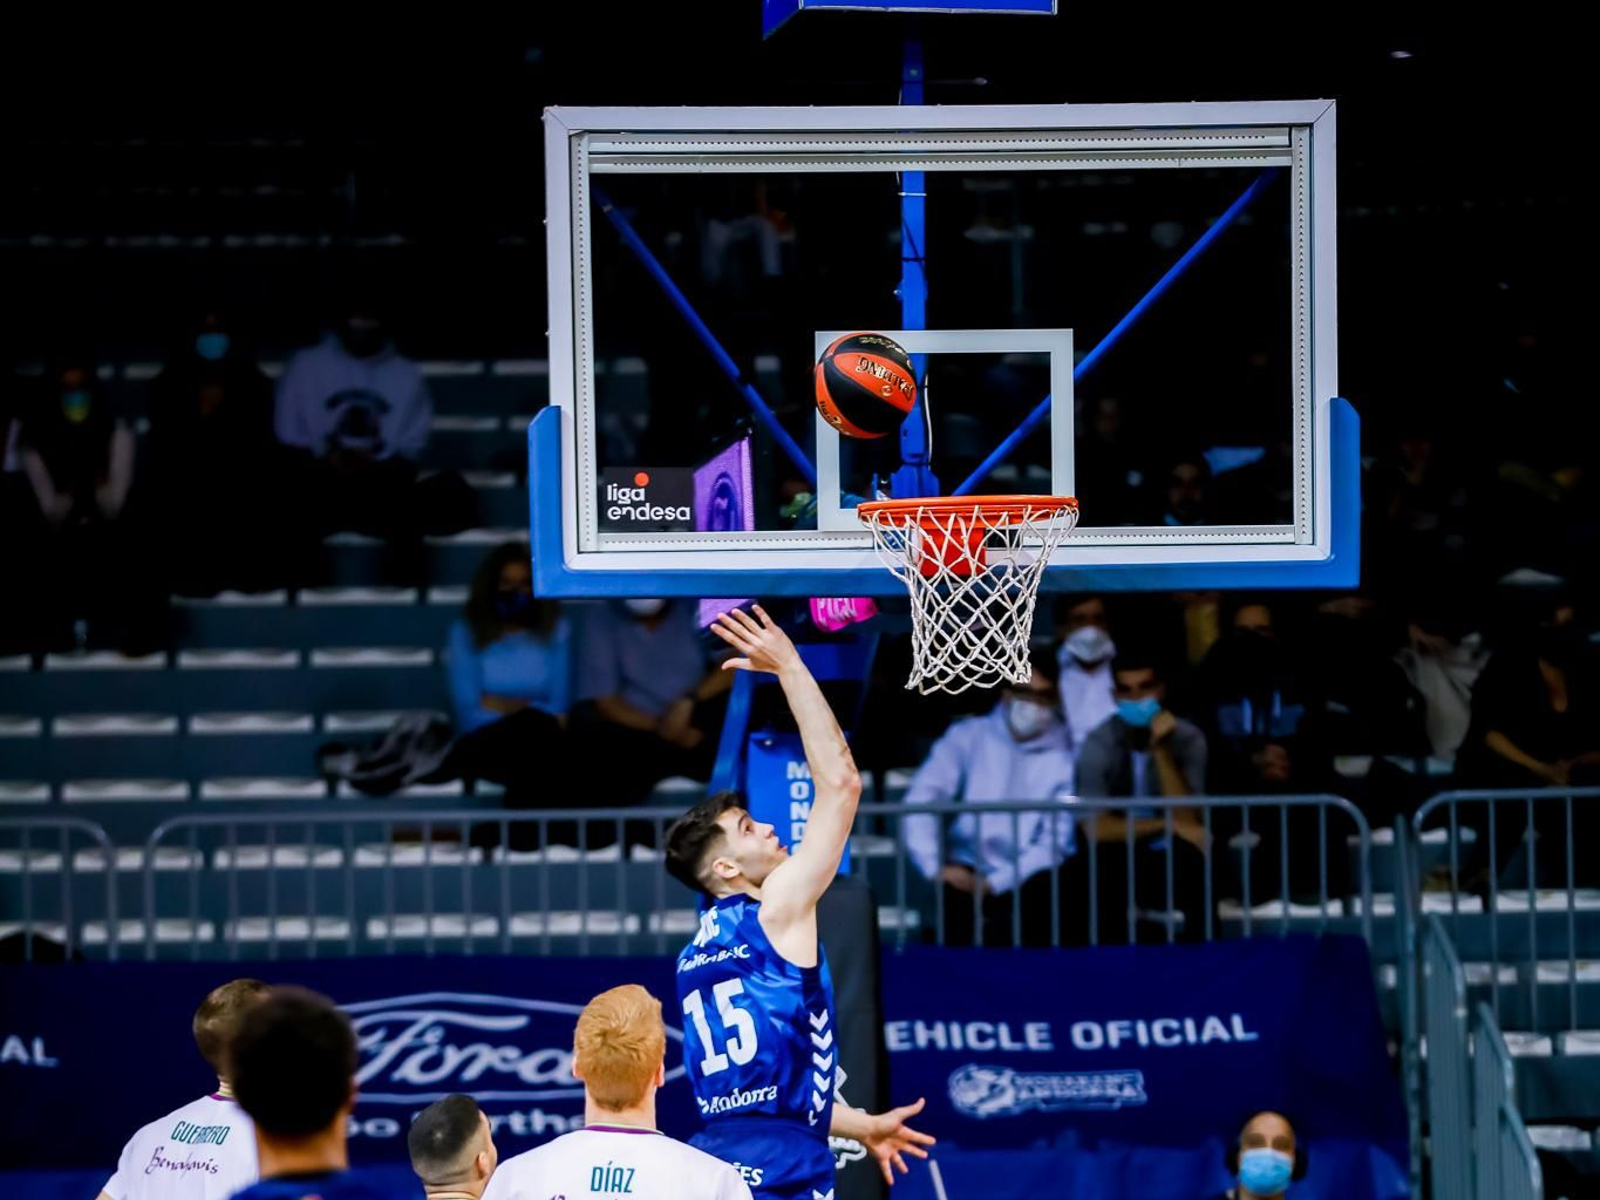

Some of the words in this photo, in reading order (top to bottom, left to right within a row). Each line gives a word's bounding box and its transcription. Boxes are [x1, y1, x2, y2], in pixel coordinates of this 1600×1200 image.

[607, 483, 645, 505] liga
[607, 502, 691, 521] endesa
[682, 977, 758, 1077] 15
[883, 1020, 1053, 1051] EHICLE
[1070, 1013, 1259, 1050] OFICIAL
[0, 1034, 59, 1068] AL
[710, 1085, 778, 1115] Andorra
[590, 1160, 635, 1194] DÍAZ
